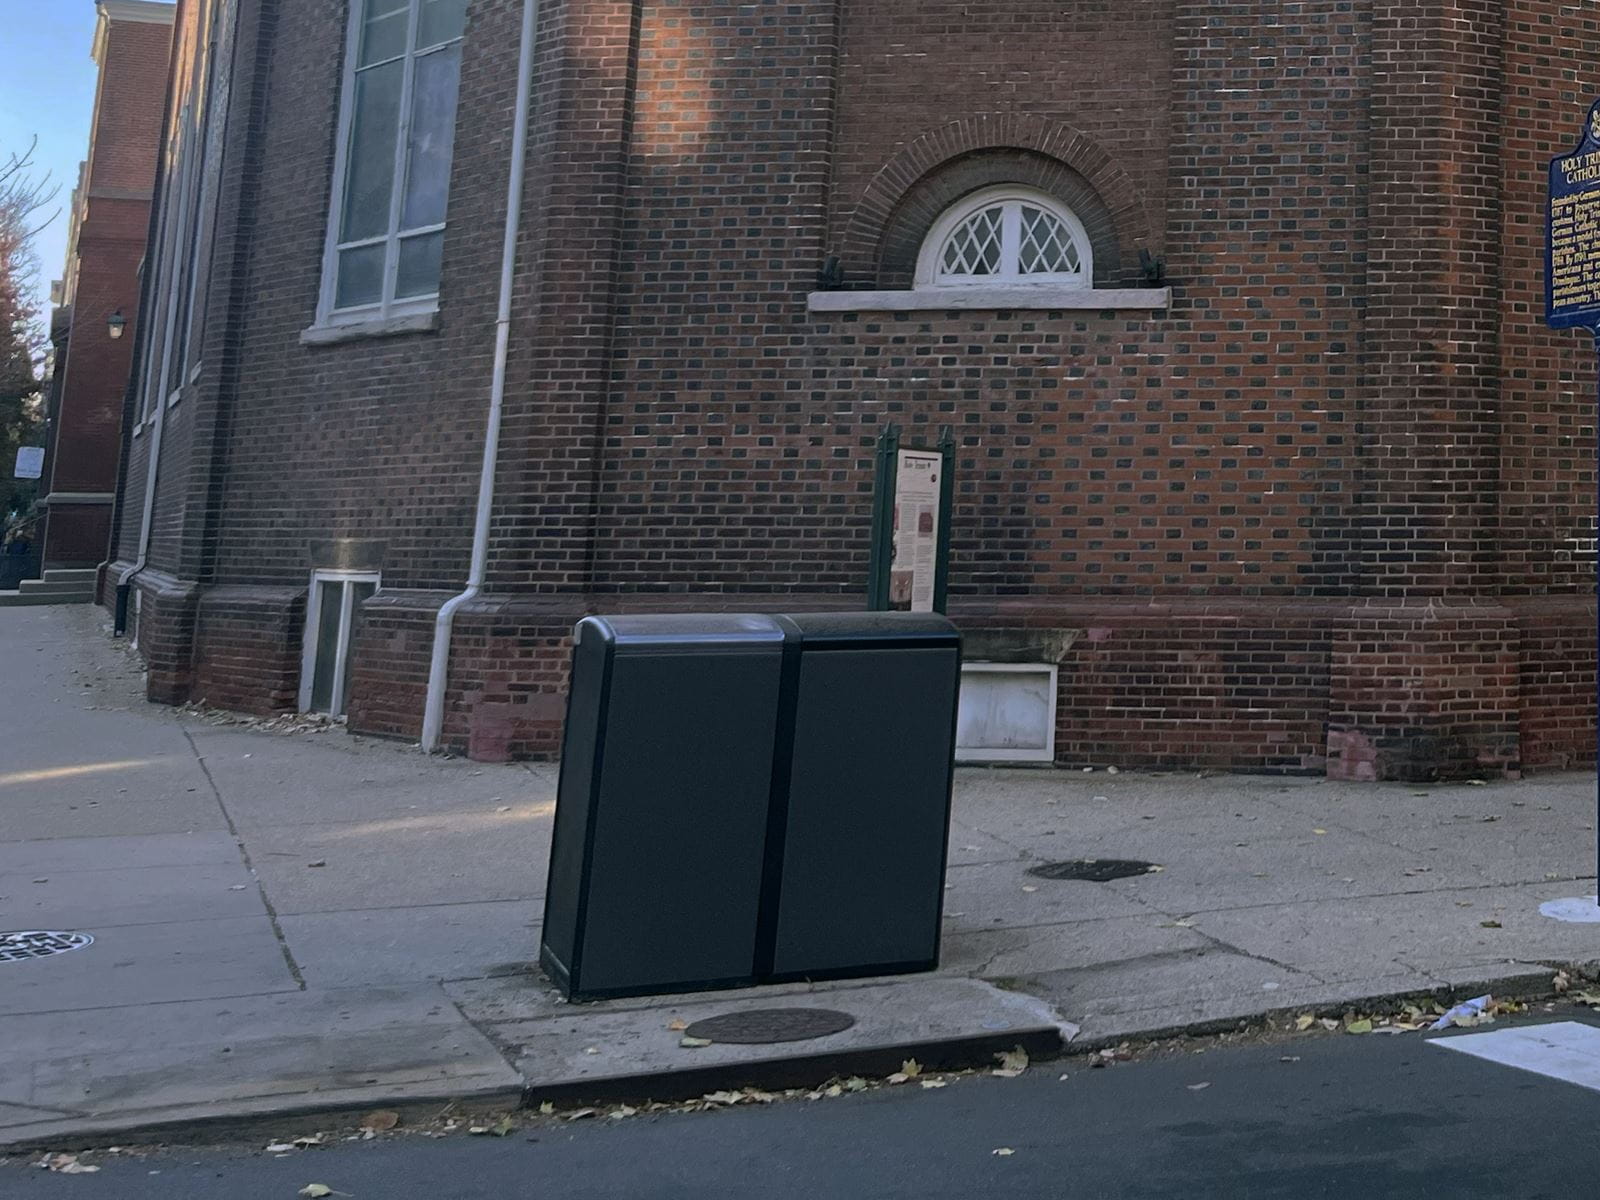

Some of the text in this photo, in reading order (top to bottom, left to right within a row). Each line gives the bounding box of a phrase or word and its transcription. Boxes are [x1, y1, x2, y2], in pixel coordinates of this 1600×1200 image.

[1561, 156, 1582, 172] HOLY
[1575, 220, 1598, 232] Catholic
[1578, 242, 1590, 252] The
[1553, 265, 1581, 276] Americans
[1582, 271, 1593, 281] The
